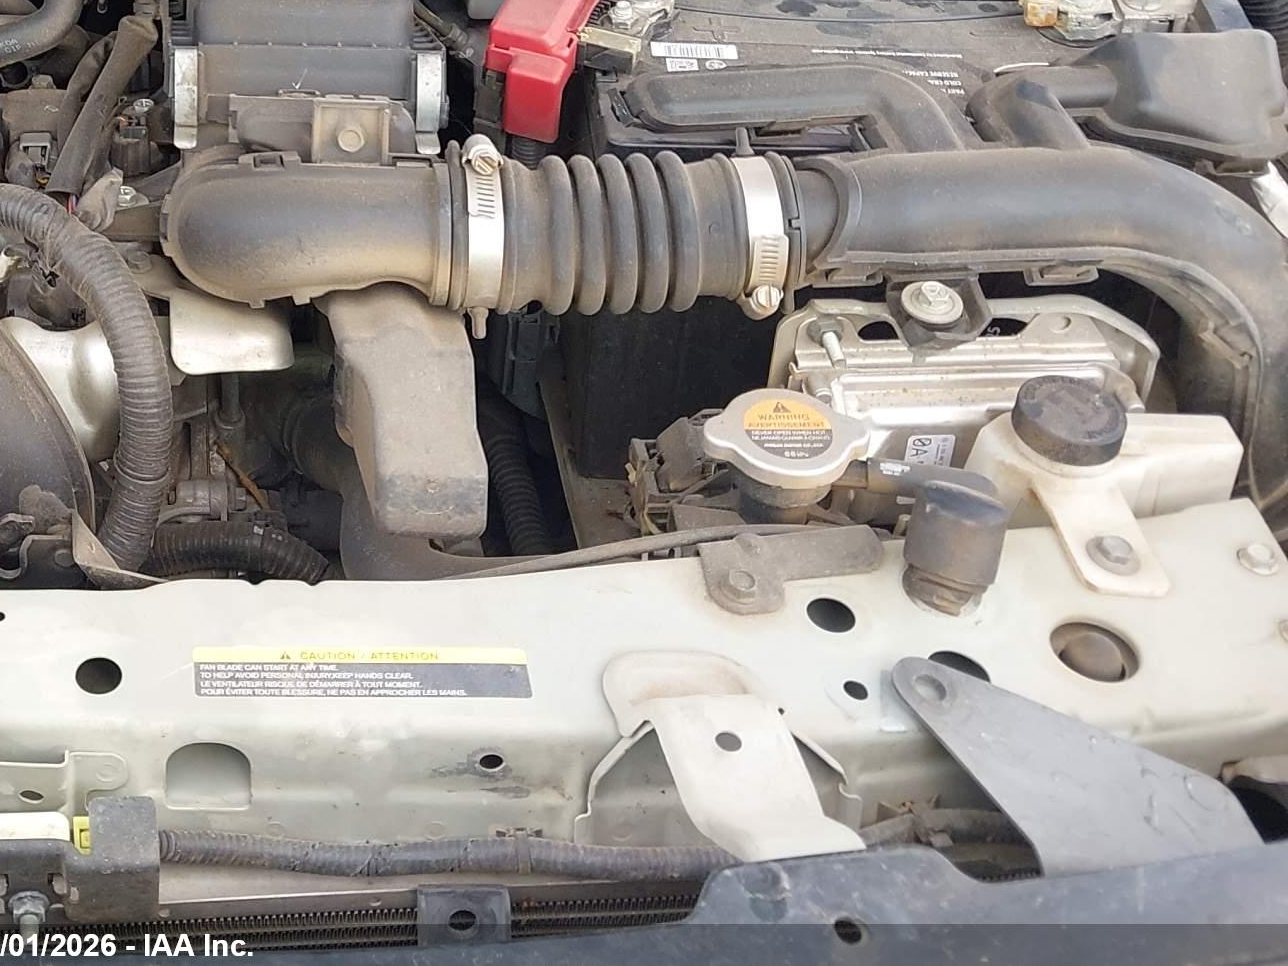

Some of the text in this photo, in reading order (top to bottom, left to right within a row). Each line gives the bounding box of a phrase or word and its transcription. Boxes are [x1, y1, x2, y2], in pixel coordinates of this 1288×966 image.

[757, 413, 811, 421] WARNING
[300, 651, 355, 660] CAUTION
[371, 649, 439, 660] ATTENTION
[265, 681, 295, 689] RISQUE
[310, 680, 353, 688] DÉMARRER
